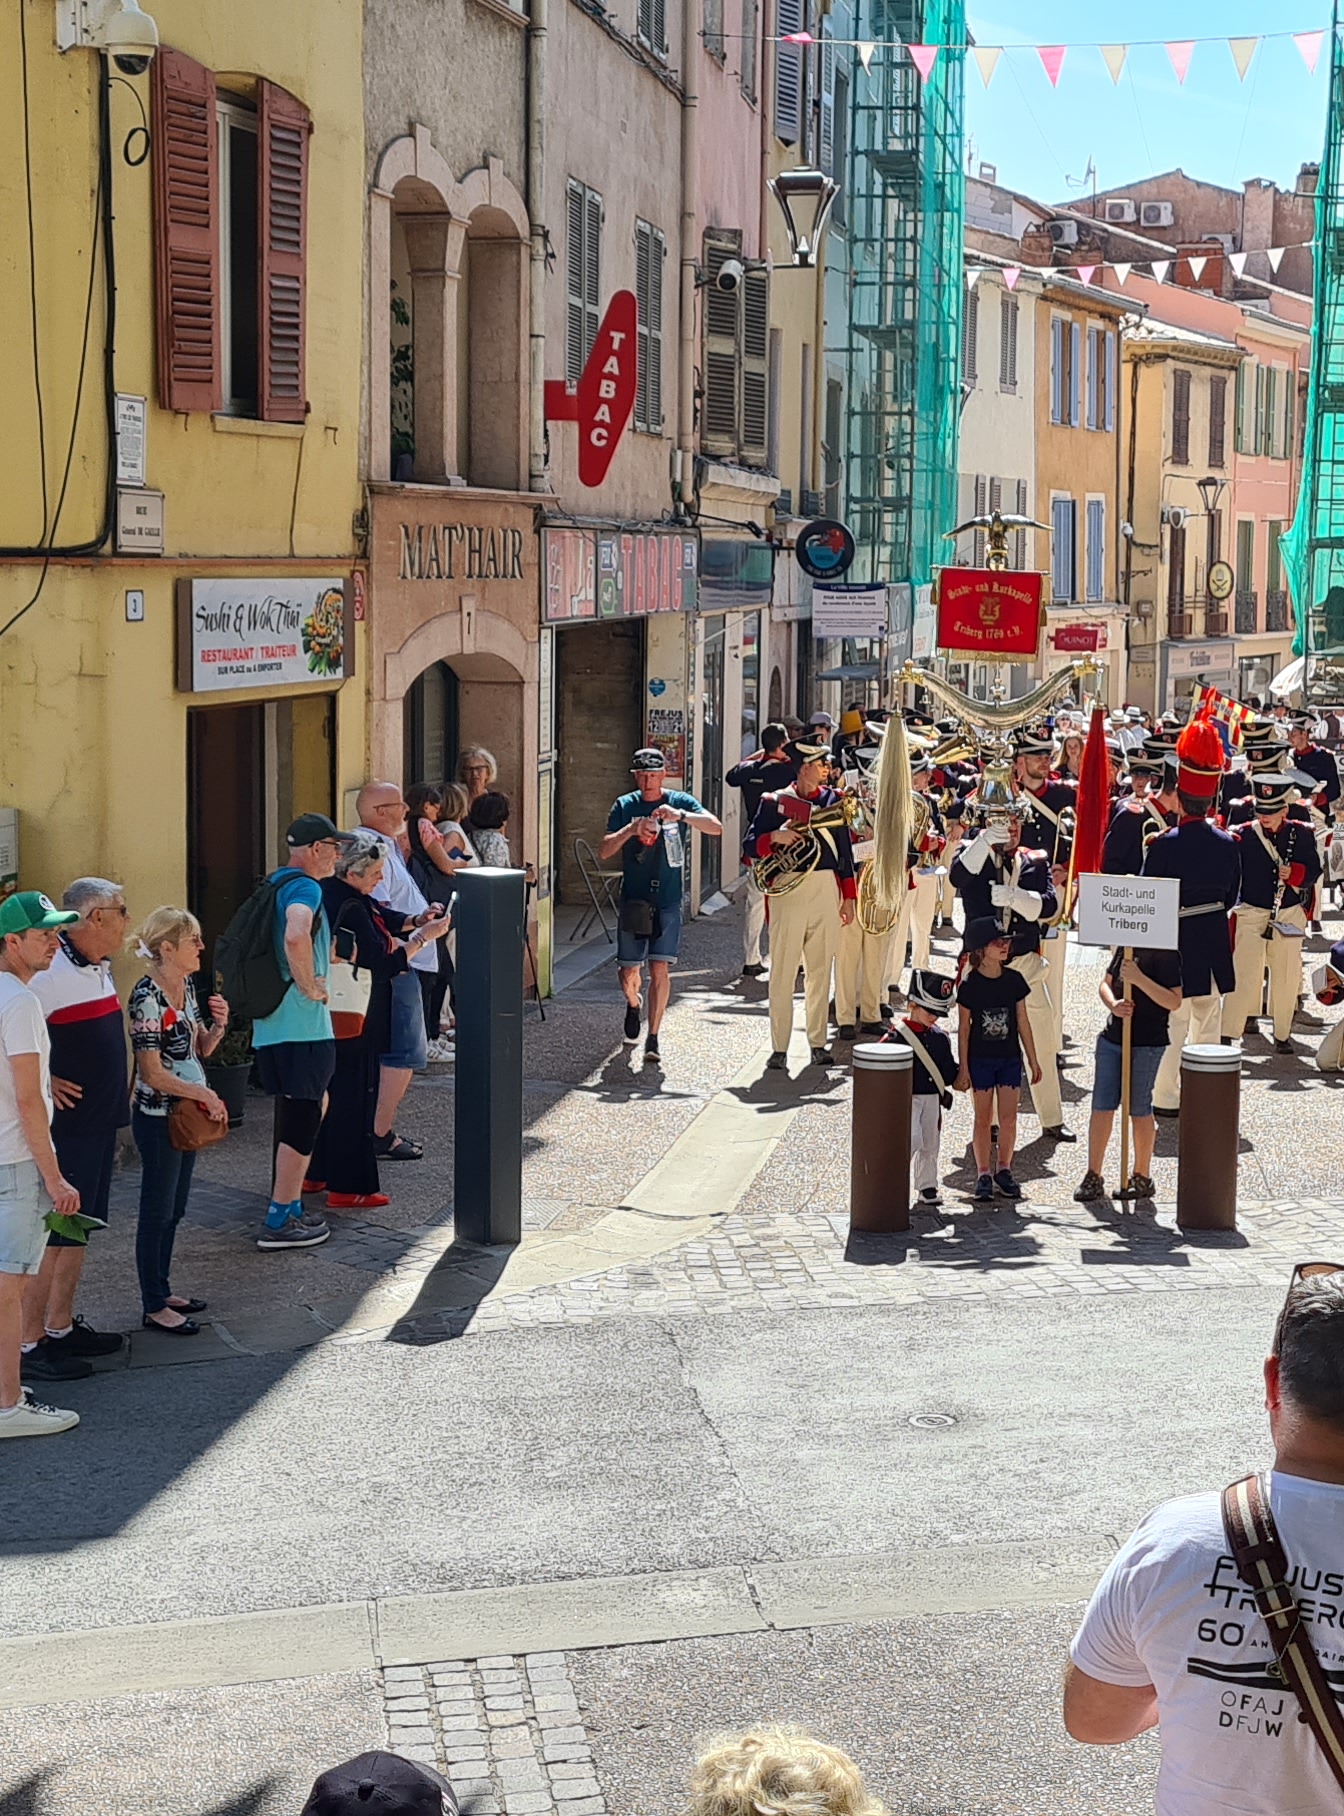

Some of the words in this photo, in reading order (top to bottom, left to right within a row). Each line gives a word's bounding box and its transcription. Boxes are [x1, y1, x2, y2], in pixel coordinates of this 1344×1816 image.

[590, 330, 626, 447] TABAC
[398, 522, 524, 580] MAT'HAIR
[621, 534, 682, 614] TABAC
[195, 601, 232, 633] Sushi
[233, 603, 245, 641] &
[247, 596, 275, 633] Wok
[273, 600, 302, 634] Thaï
[1058, 632, 1093, 645] GUINOT
[201, 647, 254, 663] RESTAURANT
[260, 644, 297, 660] TRAITEUR
[230, 665, 245, 674] PLACE
[1102, 885, 1133, 898] Stadt-
[1136, 889, 1155, 899] und
[1101, 901, 1155, 916] Kurkapelle
[1108, 917, 1148, 933] Triberg
[1221, 1690, 1284, 1716] OFAJ
[1219, 1711, 1283, 1738] DFJW
